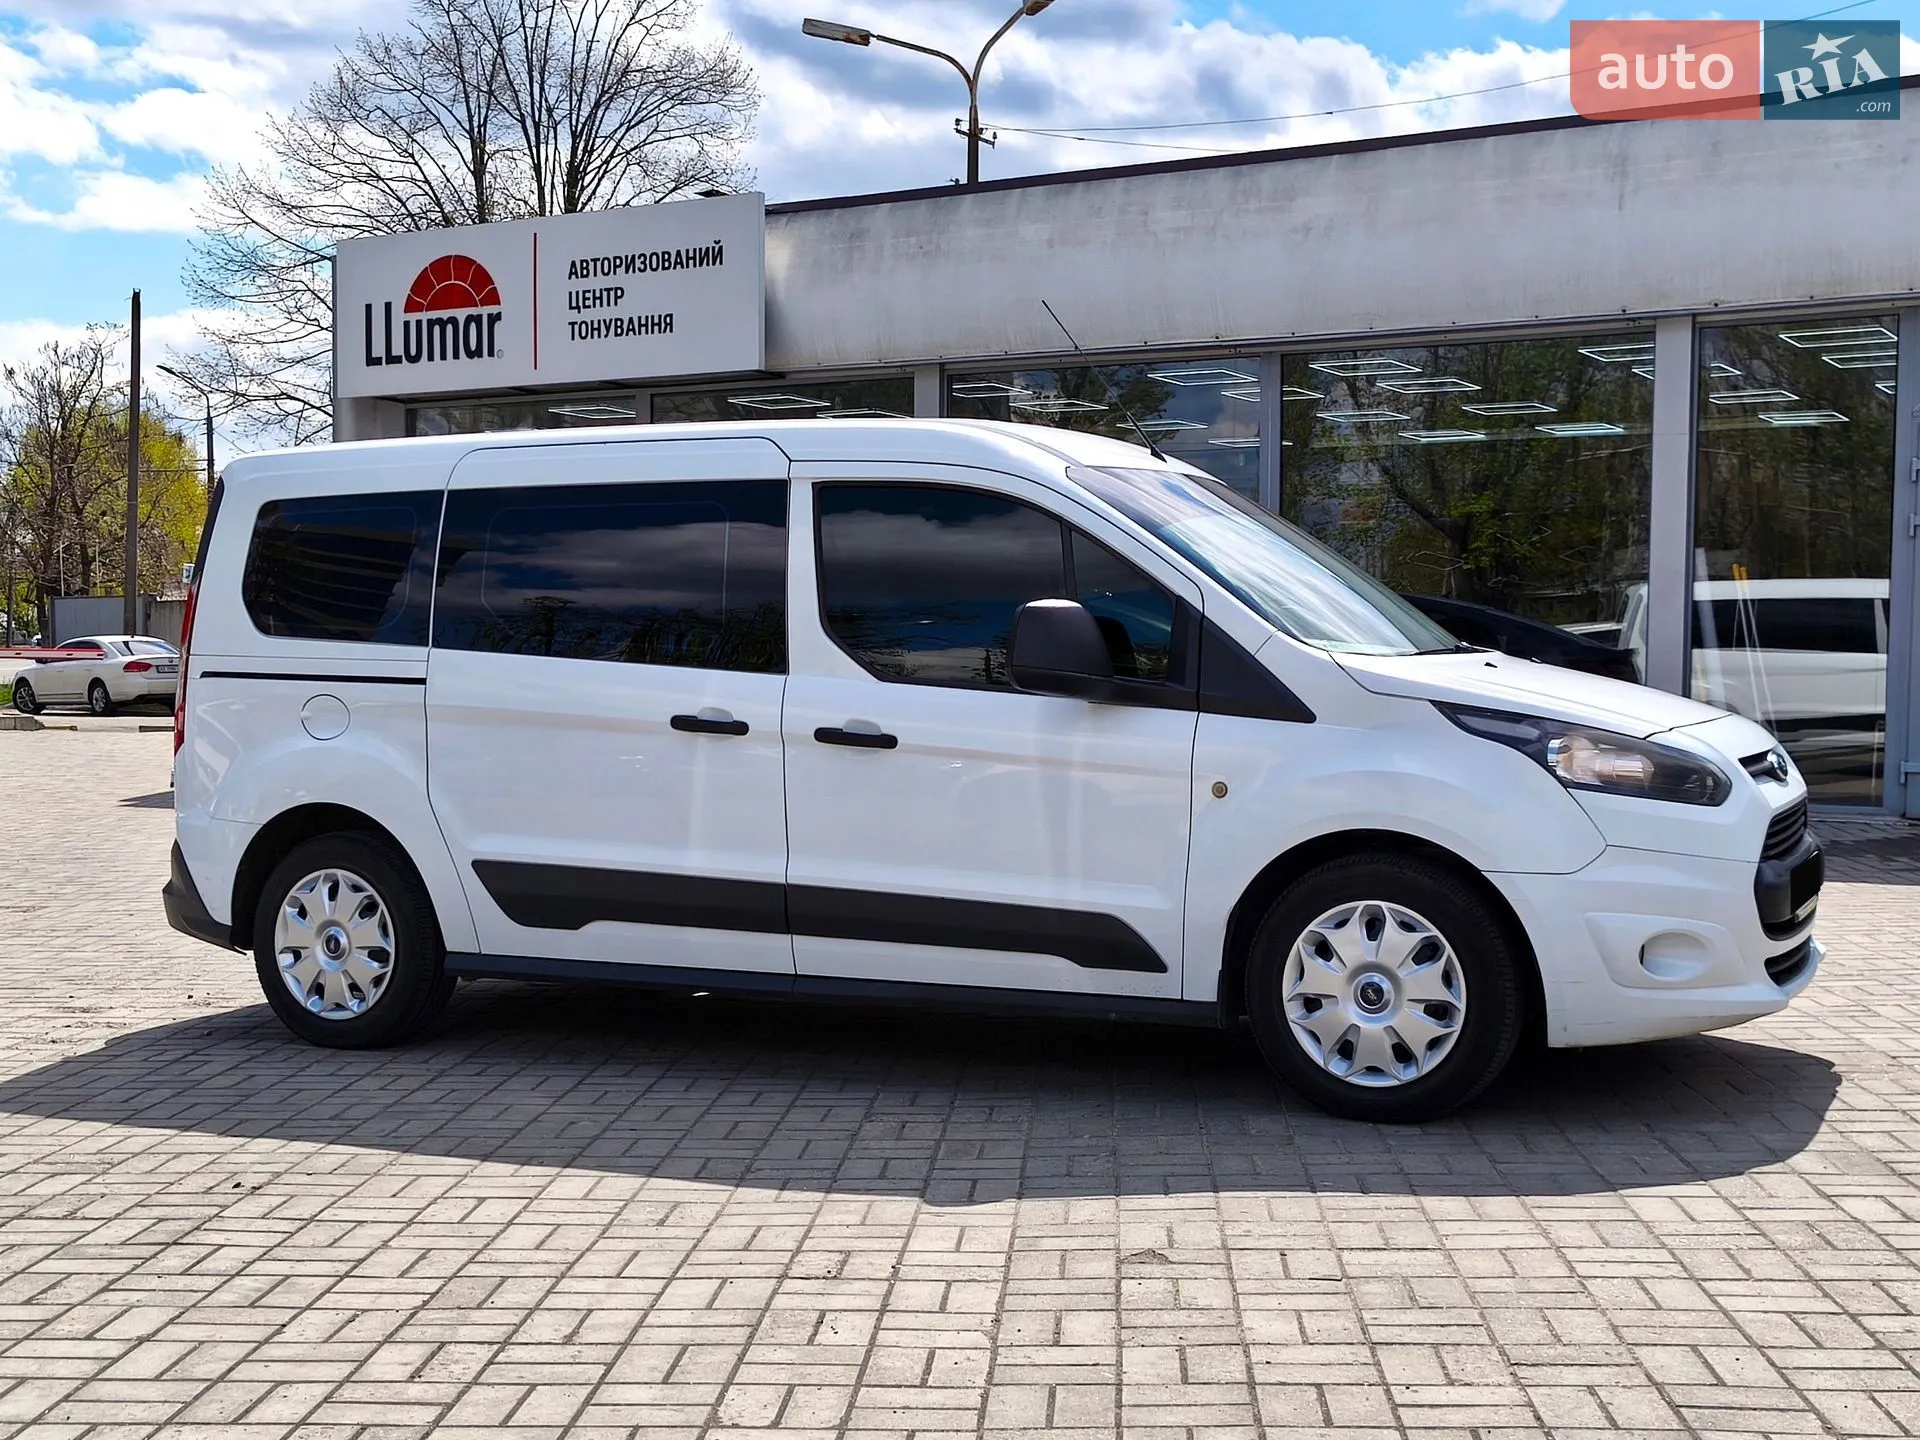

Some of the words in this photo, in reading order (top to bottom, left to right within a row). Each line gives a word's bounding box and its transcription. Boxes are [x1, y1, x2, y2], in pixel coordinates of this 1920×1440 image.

[568, 239, 724, 280] АВТОРИЗОВАНИЙ
[568, 287, 625, 314] ЦЕНТР
[365, 302, 502, 367] LLumar
[568, 313, 674, 341] ТОНУВАННЯ
